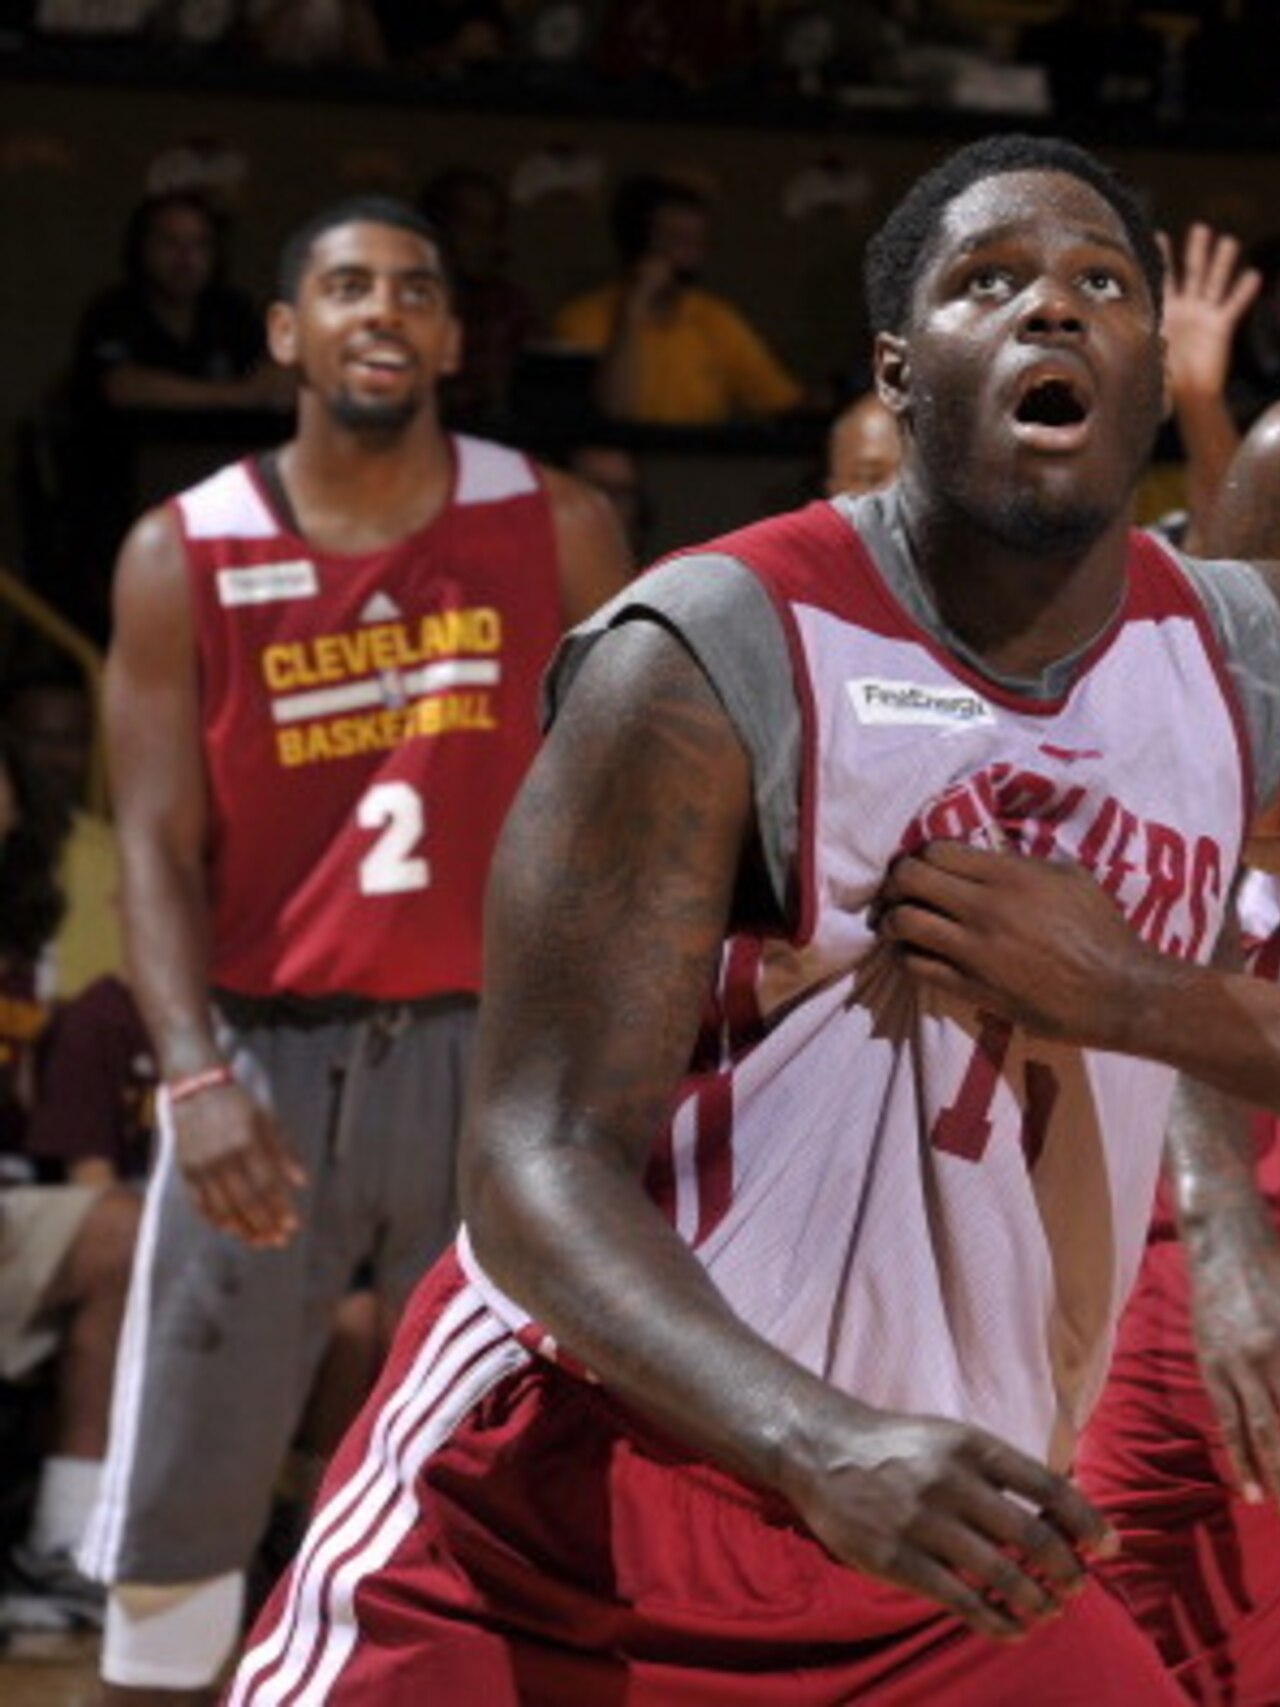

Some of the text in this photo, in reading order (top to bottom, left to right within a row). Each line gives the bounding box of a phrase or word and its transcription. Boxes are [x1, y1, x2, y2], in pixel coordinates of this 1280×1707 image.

[261, 607, 501, 691] CLEVELAND
[276, 693, 496, 767] BASKETBALL
[356, 779, 430, 895] 2
